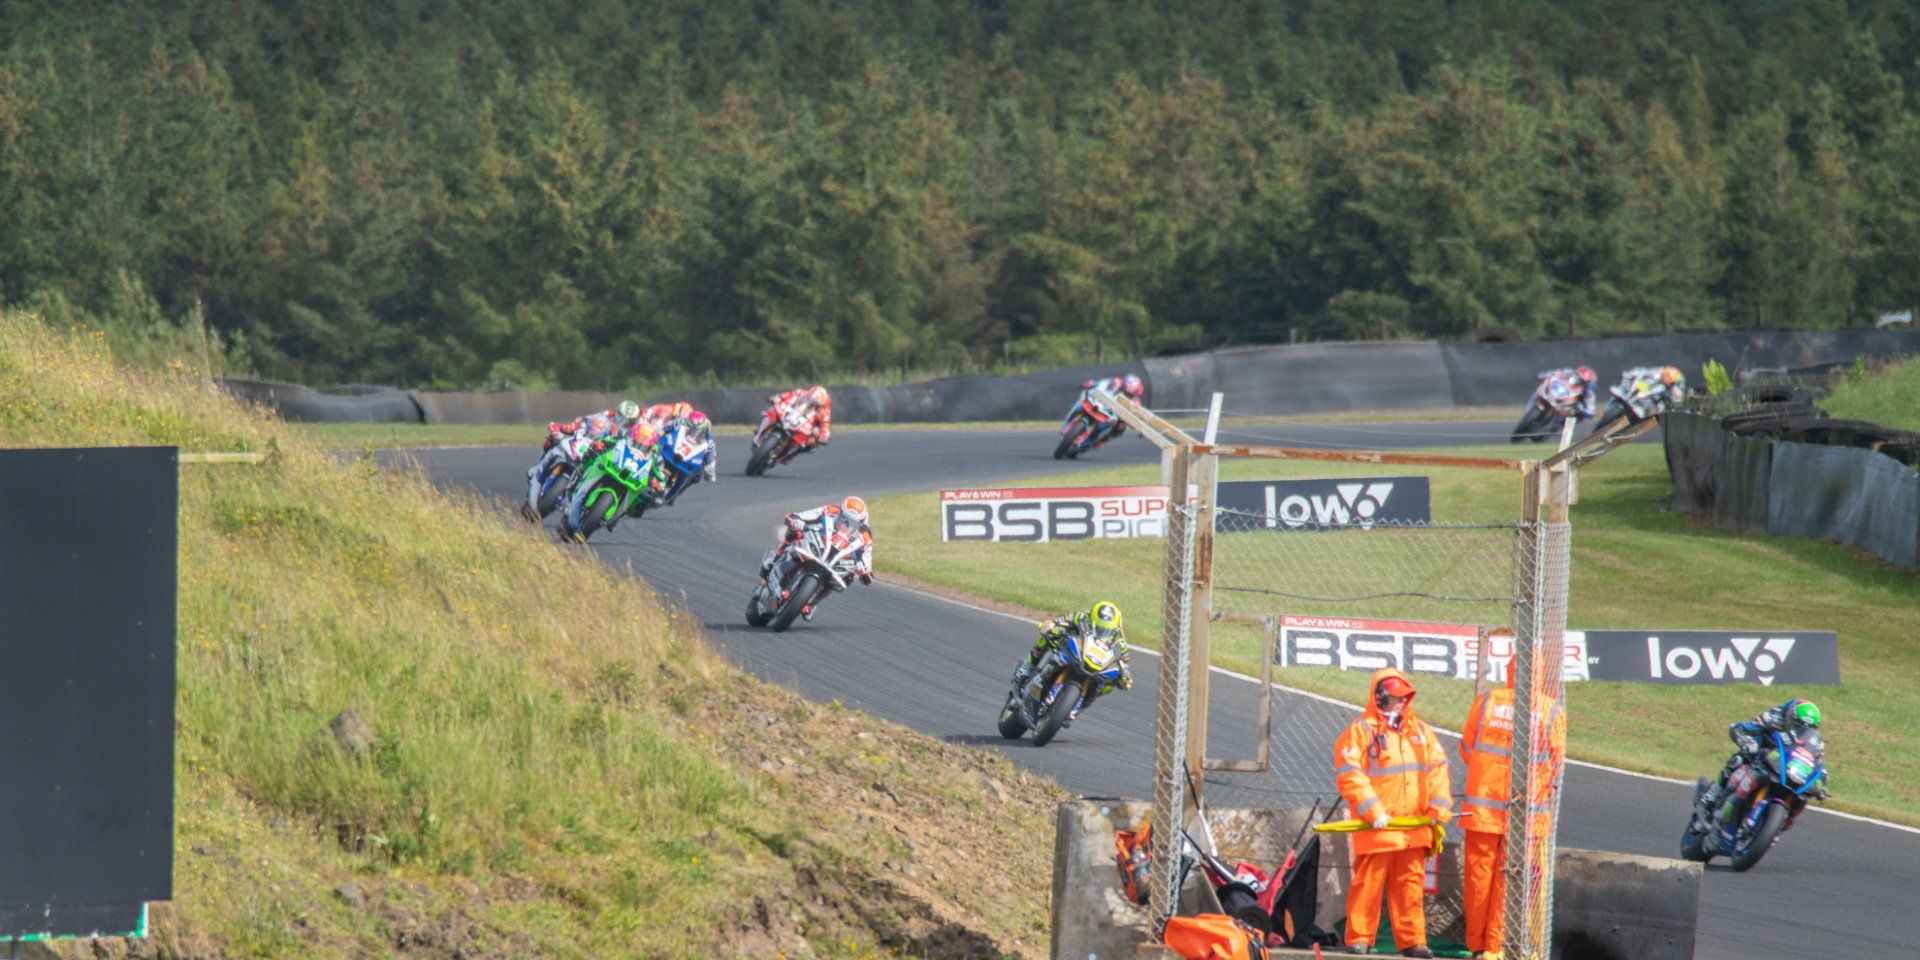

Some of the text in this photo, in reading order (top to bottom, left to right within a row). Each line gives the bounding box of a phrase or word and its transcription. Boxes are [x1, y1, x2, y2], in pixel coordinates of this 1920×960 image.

[946, 501, 1095, 542] BSB
[1101, 497, 1198, 516] SUP
[1287, 630, 1458, 677] BSB
[1588, 656, 1600, 665] BY
